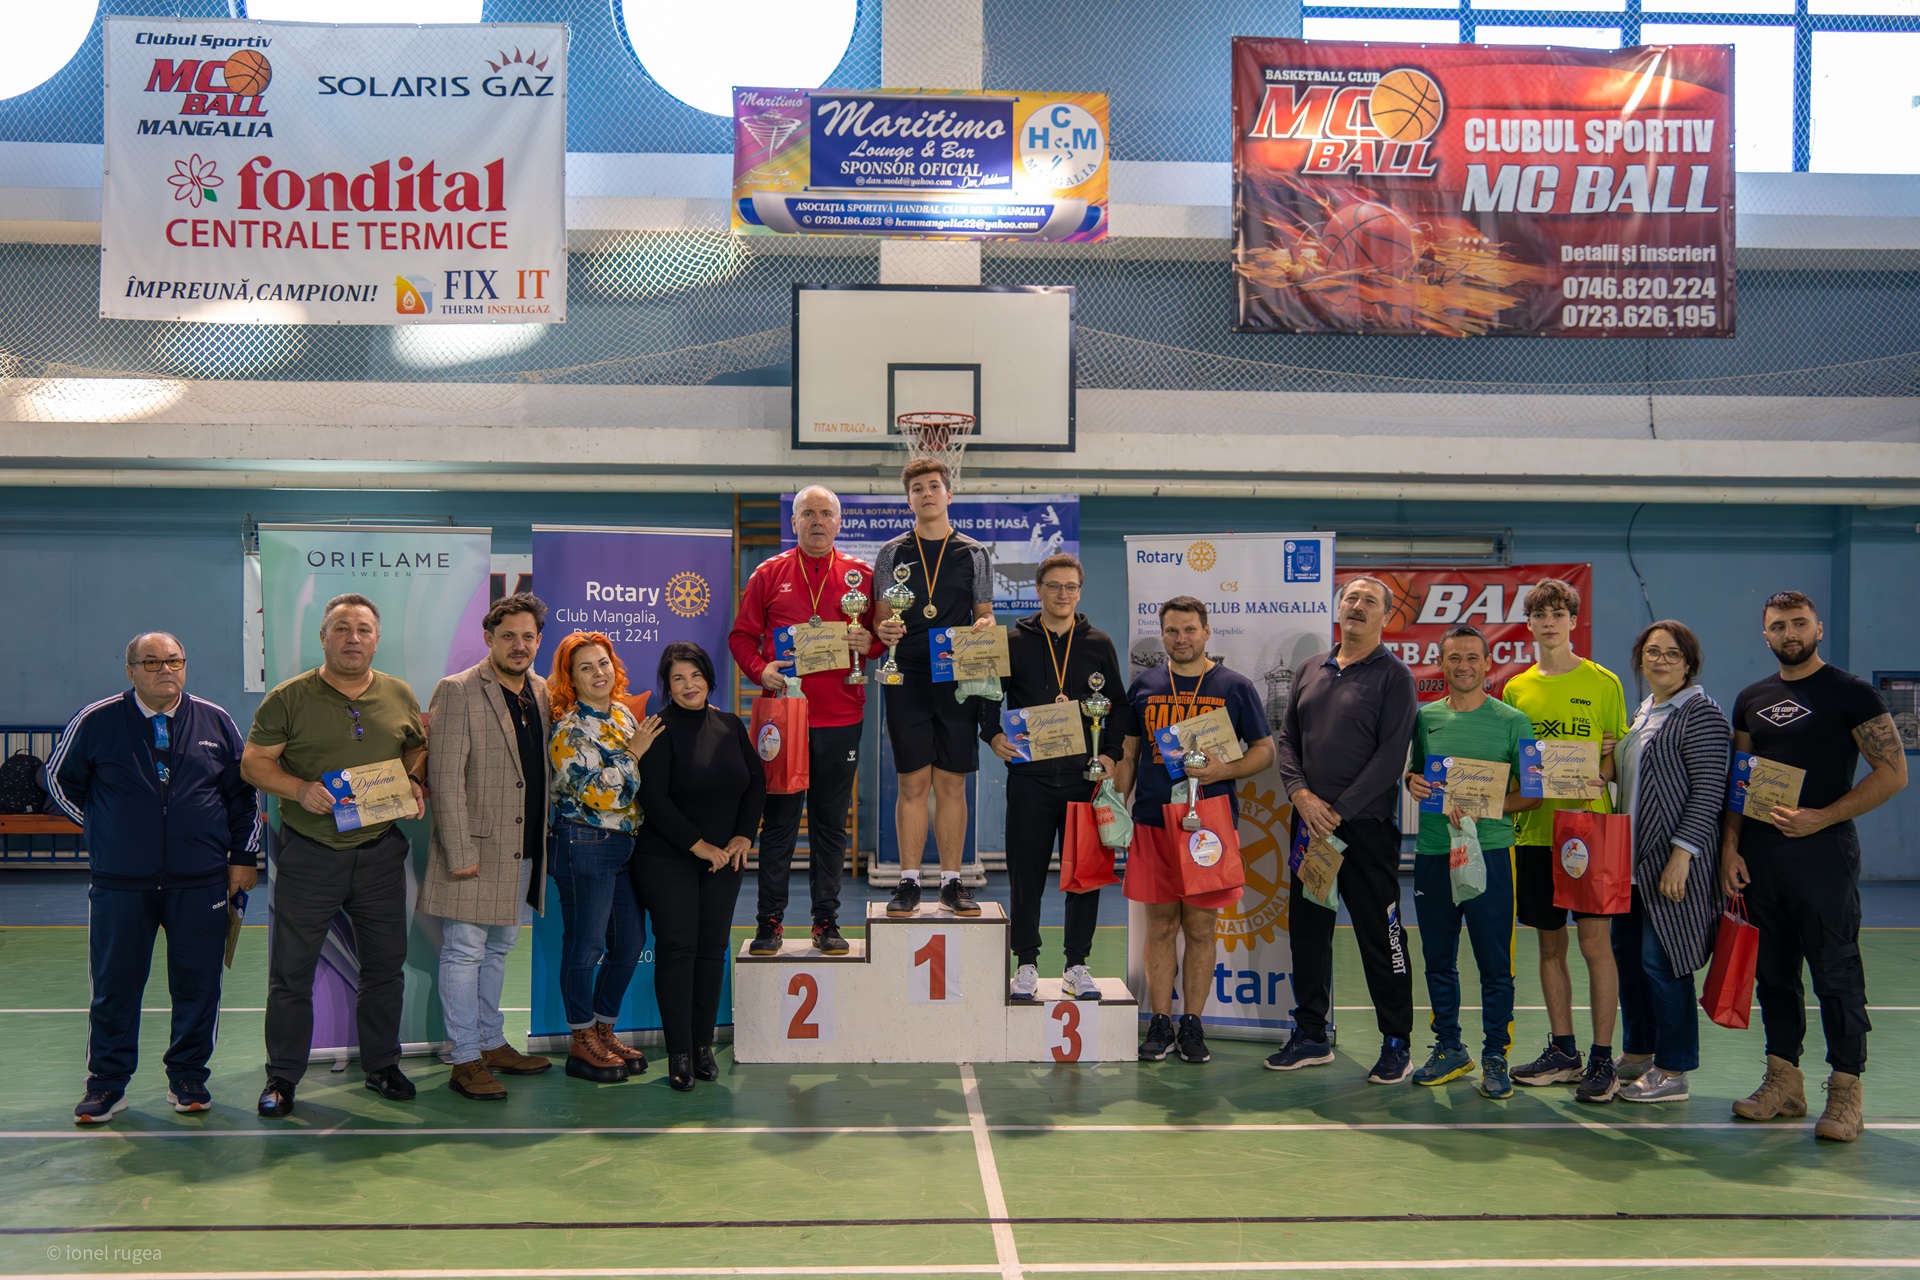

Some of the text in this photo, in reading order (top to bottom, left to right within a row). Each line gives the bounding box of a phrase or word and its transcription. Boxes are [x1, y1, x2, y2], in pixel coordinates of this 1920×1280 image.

[136, 32, 272, 50] Clubul Sportiv
[318, 76, 554, 97] SOLARIS GAZ
[1265, 69, 1380, 83] BASKETBALL CLUB
[179, 94, 269, 116] BALL
[739, 92, 802, 107] Maritimo
[137, 120, 274, 137] MANGALIA
[818, 100, 1005, 140] Maritimo
[1464, 118, 1714, 154] CLUBUL SPORTIV
[849, 140, 975, 162] Lounge & Bar
[1301, 140, 1437, 177] BALL
[840, 161, 982, 177] SPONSOR OFICIAL
[1026, 157, 1098, 187] MAGALIA
[237, 155, 506, 212] fondital
[865, 176, 953, 187] dan.mold@yahoo.com
[1461, 164, 1720, 214] MC BALL
[847, 203, 893, 213] SPORTIVĂ
[895, 205, 940, 214] HANDBAL
[942, 205, 967, 215] CLUB
[969, 205, 995, 215] MUN.
[997, 206, 1046, 216] MANGALIA
[814, 215, 882, 226] 0730.186.623
[895, 217, 1038, 231] hcmmangalia22@yahoo.com
[166, 218, 507, 250] CENTRALE TERMICE
[1561, 245, 1619, 262] Detalii
[1640, 245, 1716, 262] înscrieri
[443, 269, 550, 300] FIX IT
[1563, 277, 1717, 299] 0746.820.224
[440, 304, 550, 315] THERM INSTALGAZ
[1562, 305, 1716, 327] 0723.626.195
[813, 422, 838, 432] TITAN
[839, 519, 867, 529] UPA
[949, 519, 973, 529] ENIS
[976, 519, 993, 529] DE
[994, 515, 1030, 529] MASĂ
[307, 550, 450, 568] ORIFLAME
[1137, 550, 1183, 565] Rotary
[586, 581, 660, 606] Rotary
[1416, 584, 1545, 624] BAL
[556, 608, 660, 626] Club Mangalia,
[1204, 601, 1241, 614] CLUB
[1245, 601, 1329, 614] MANGALIA
[625, 628, 658, 642] 2241
[794, 628, 835, 651] Diploma
[1213, 626, 1245, 636] Republic
[951, 631, 996, 656] Diploma
[1418, 680, 1445, 691] 0723
[1570, 698, 1592, 706] GEWO
[1026, 709, 1070, 736] Diploma
[1531, 719, 1591, 738] EXUS
[1542, 748, 1587, 771] Diploma
[351, 768, 396, 799] Diploma
[1446, 767, 1495, 788] Diploma
[1749, 768, 1791, 789] Diploma
[1215, 894, 1289, 934] NATIONAL
[914, 934, 946, 1000] 1
[786, 973, 819, 1039] 2
[1050, 1001, 1082, 1062] 3
